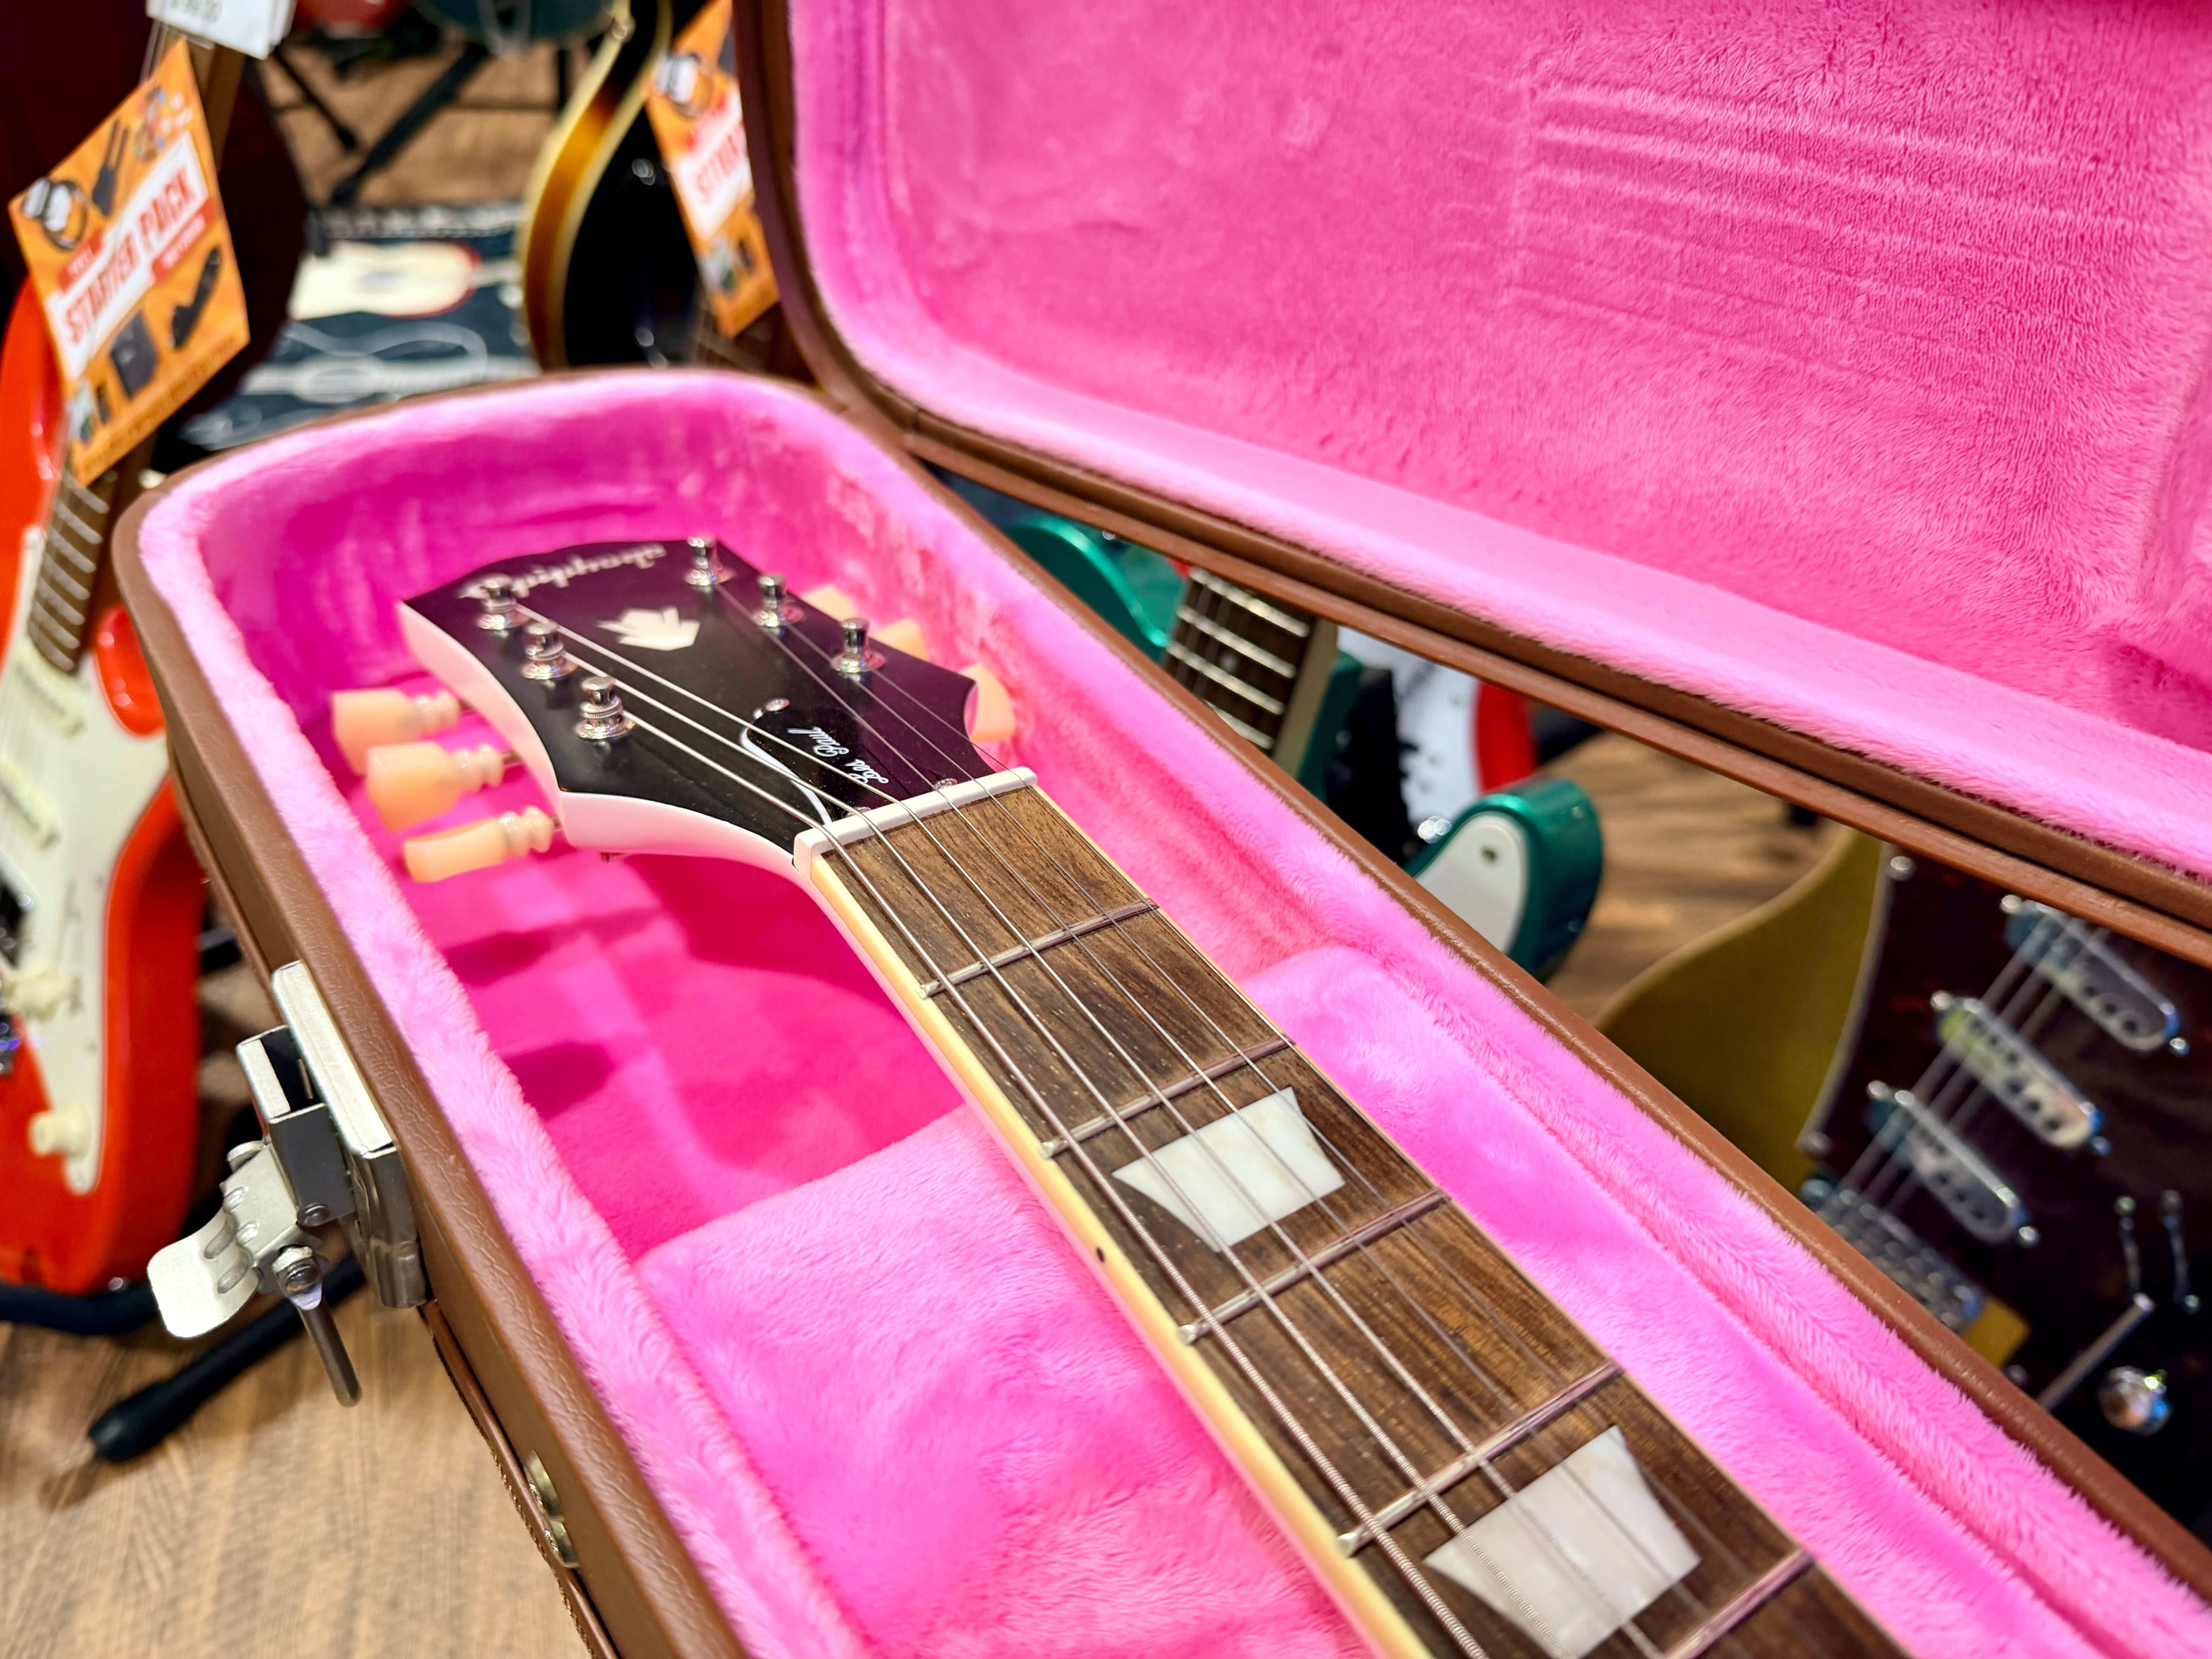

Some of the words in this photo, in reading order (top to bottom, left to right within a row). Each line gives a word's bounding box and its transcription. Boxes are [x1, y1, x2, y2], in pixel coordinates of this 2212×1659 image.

[66, 232, 138, 345] STARTER
[137, 166, 191, 251] PACK
[787, 726, 850, 757] Paul
[846, 759, 889, 785] Les
